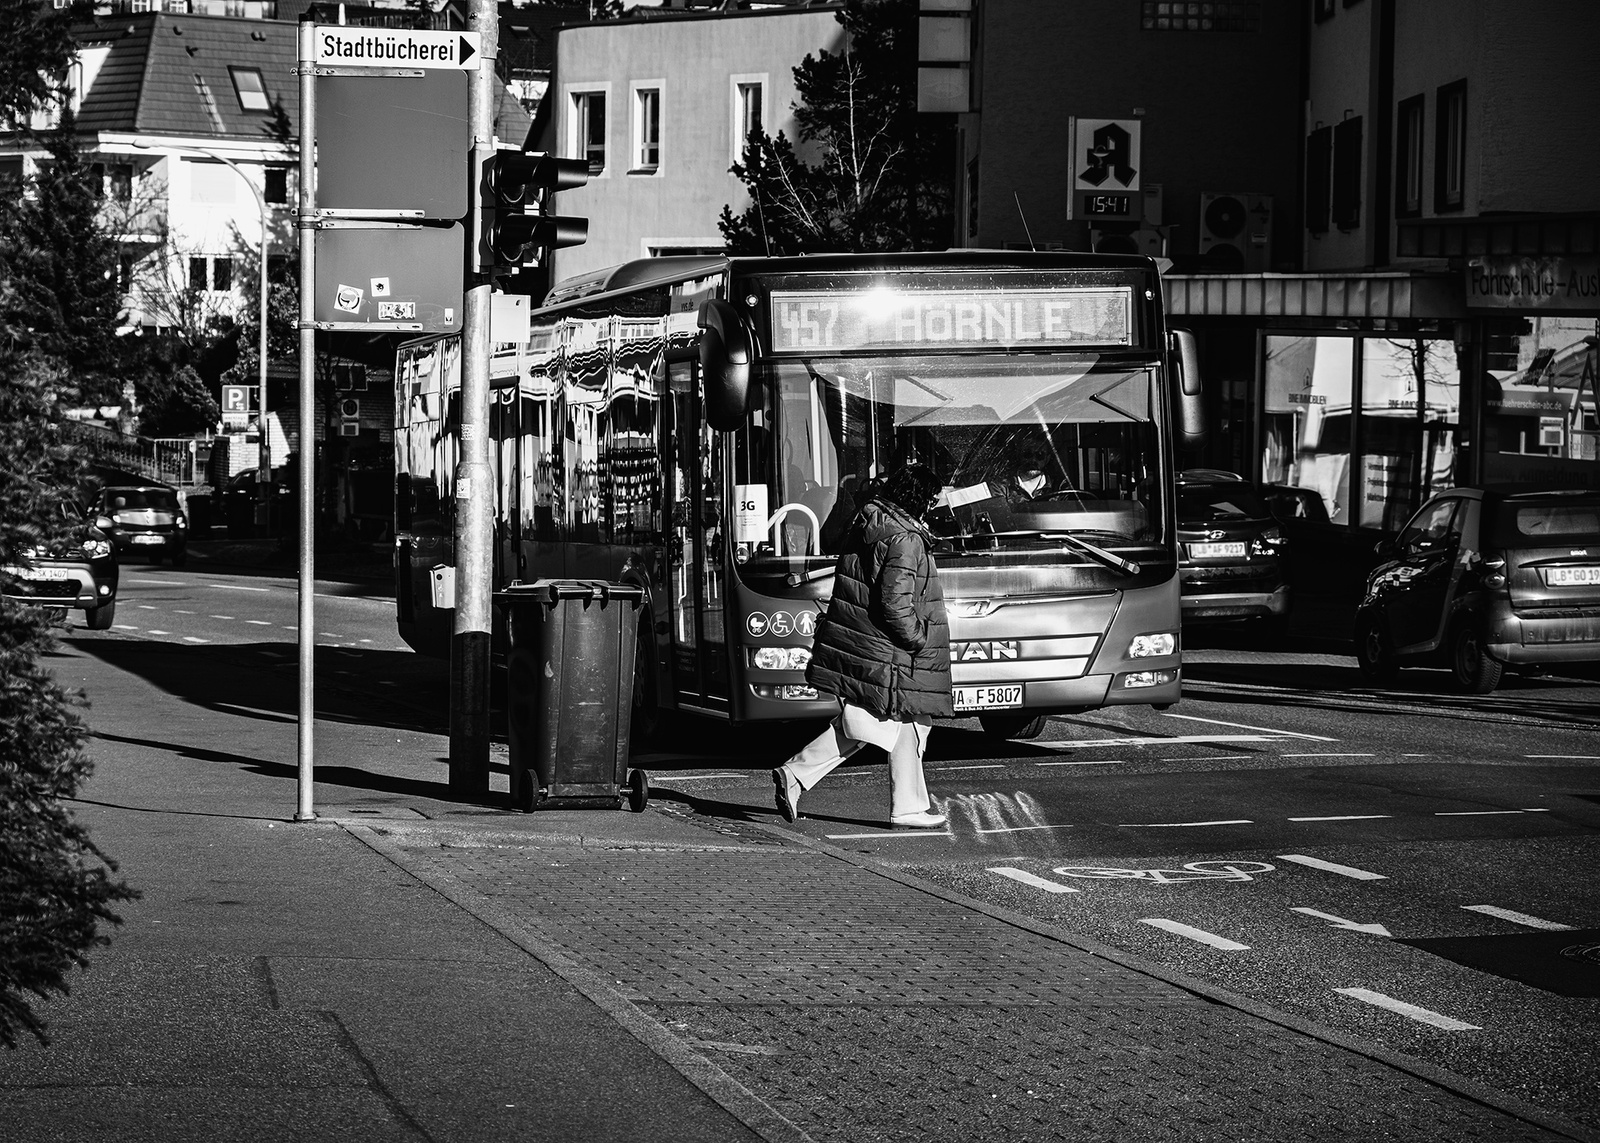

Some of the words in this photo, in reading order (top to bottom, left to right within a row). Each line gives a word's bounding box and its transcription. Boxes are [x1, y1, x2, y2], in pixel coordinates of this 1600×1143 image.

[324, 35, 453, 61] Stadtbücherei
[1092, 197, 1127, 212] 15:41
[780, 302, 838, 346] 457
[896, 301, 1071, 341] HÖRNLE
[229, 389, 243, 409] P
[1487, 398, 1562, 411] www.fuehrerschein-abc.de
[741, 500, 755, 511] 3G
[1224, 543, 1243, 554] 9217
[1554, 570, 1567, 581] LB
[950, 641, 1018, 661] AN
[952, 690, 965, 705] A
[977, 689, 984, 704] F
[988, 687, 1020, 704] 5807
